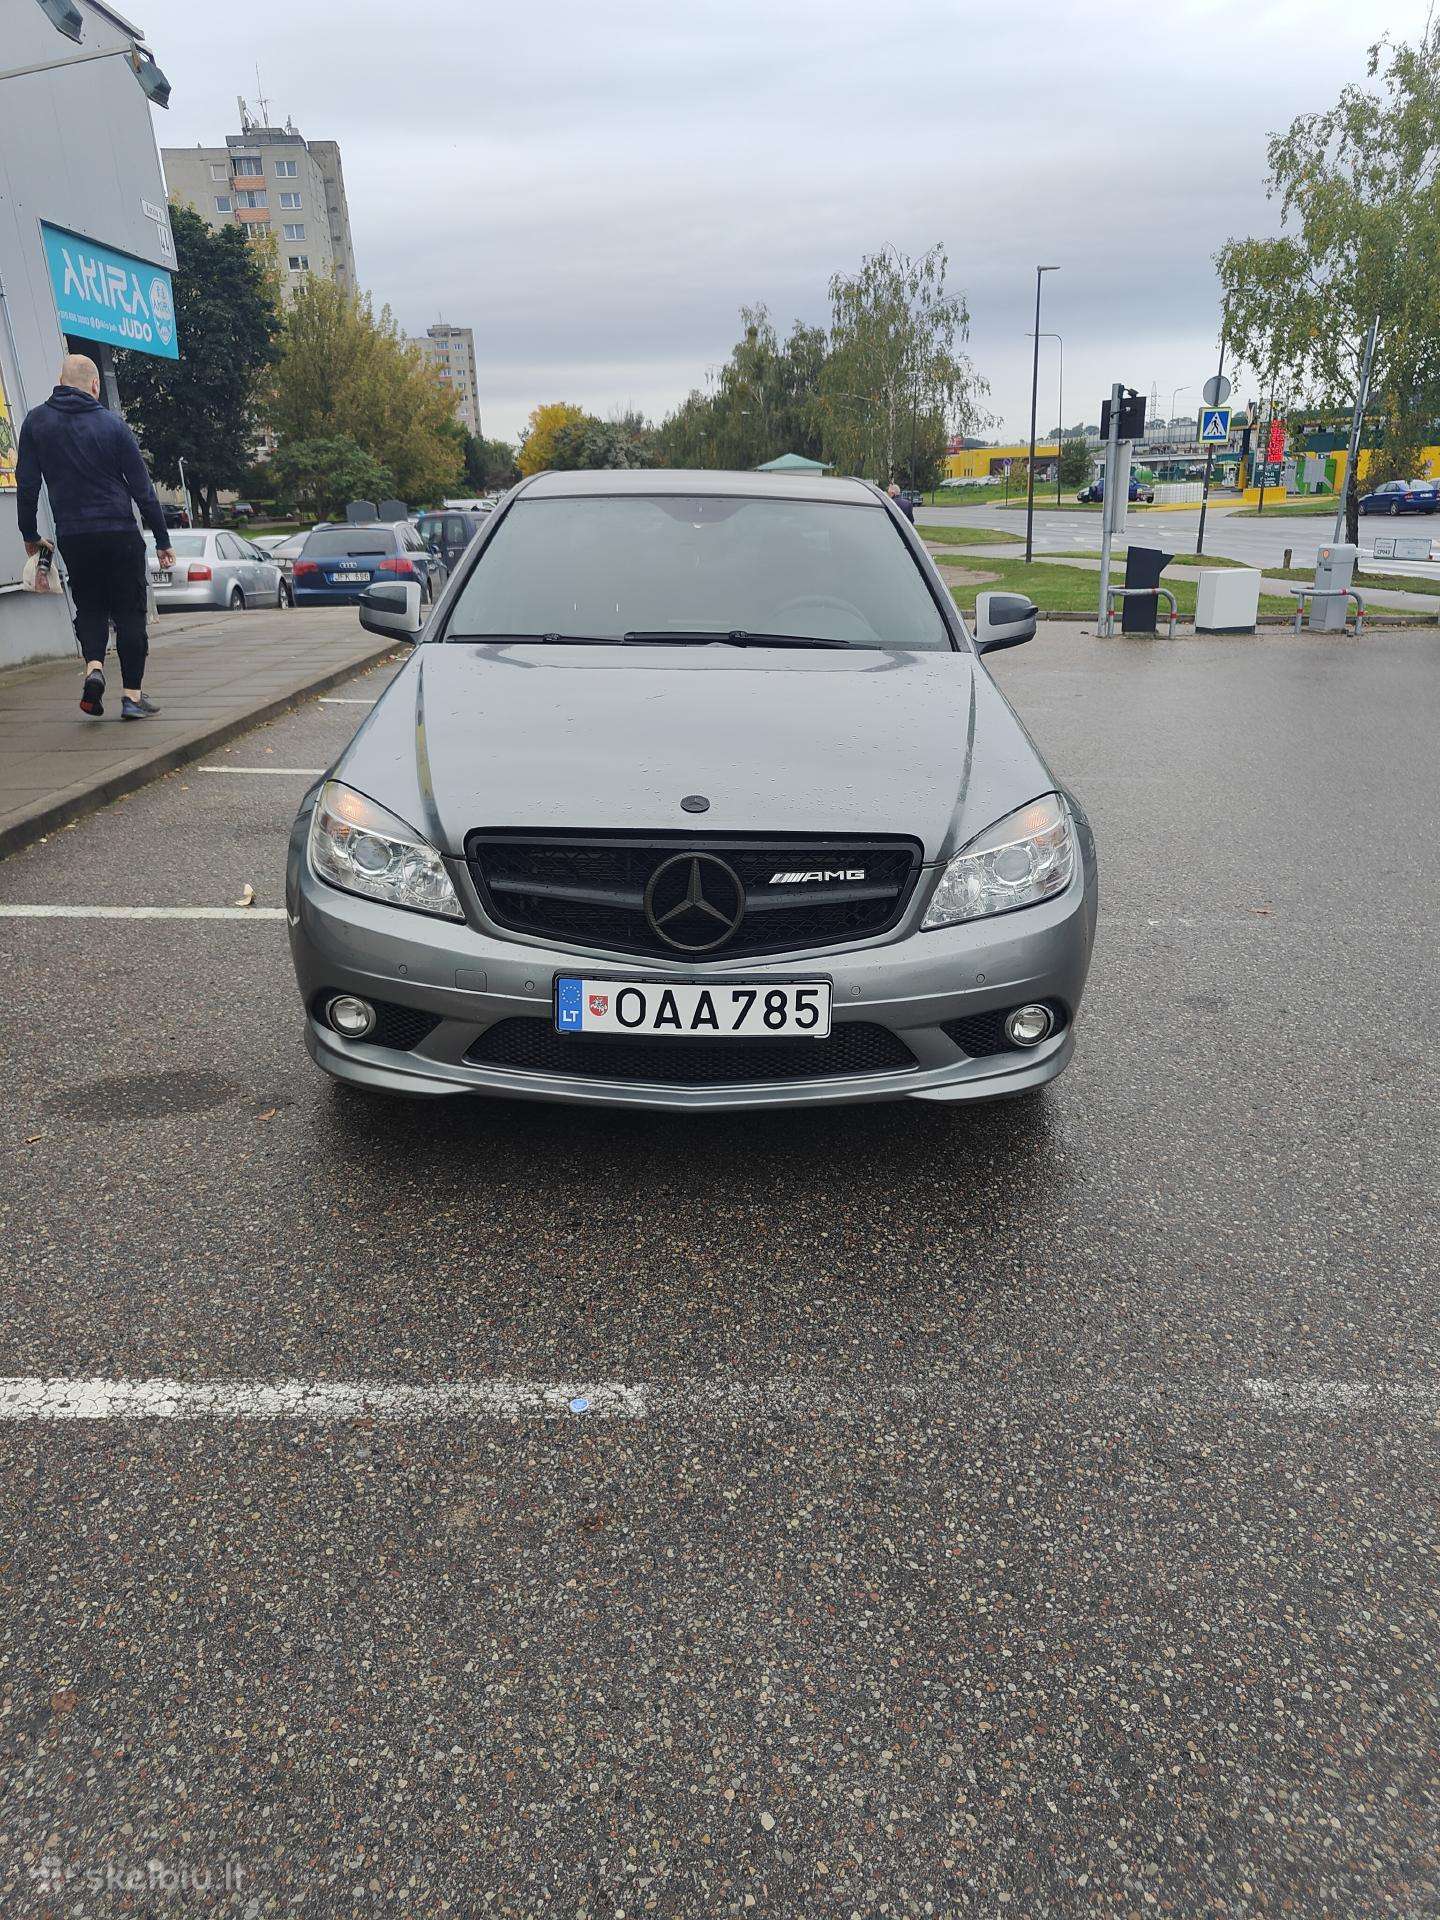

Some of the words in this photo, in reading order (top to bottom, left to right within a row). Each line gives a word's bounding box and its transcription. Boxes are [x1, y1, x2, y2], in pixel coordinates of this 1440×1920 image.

[62, 248, 150, 319] AKIRA
[119, 317, 152, 342] JUDO
[803, 869, 865, 882] AMG
[562, 1010, 579, 1023] LT
